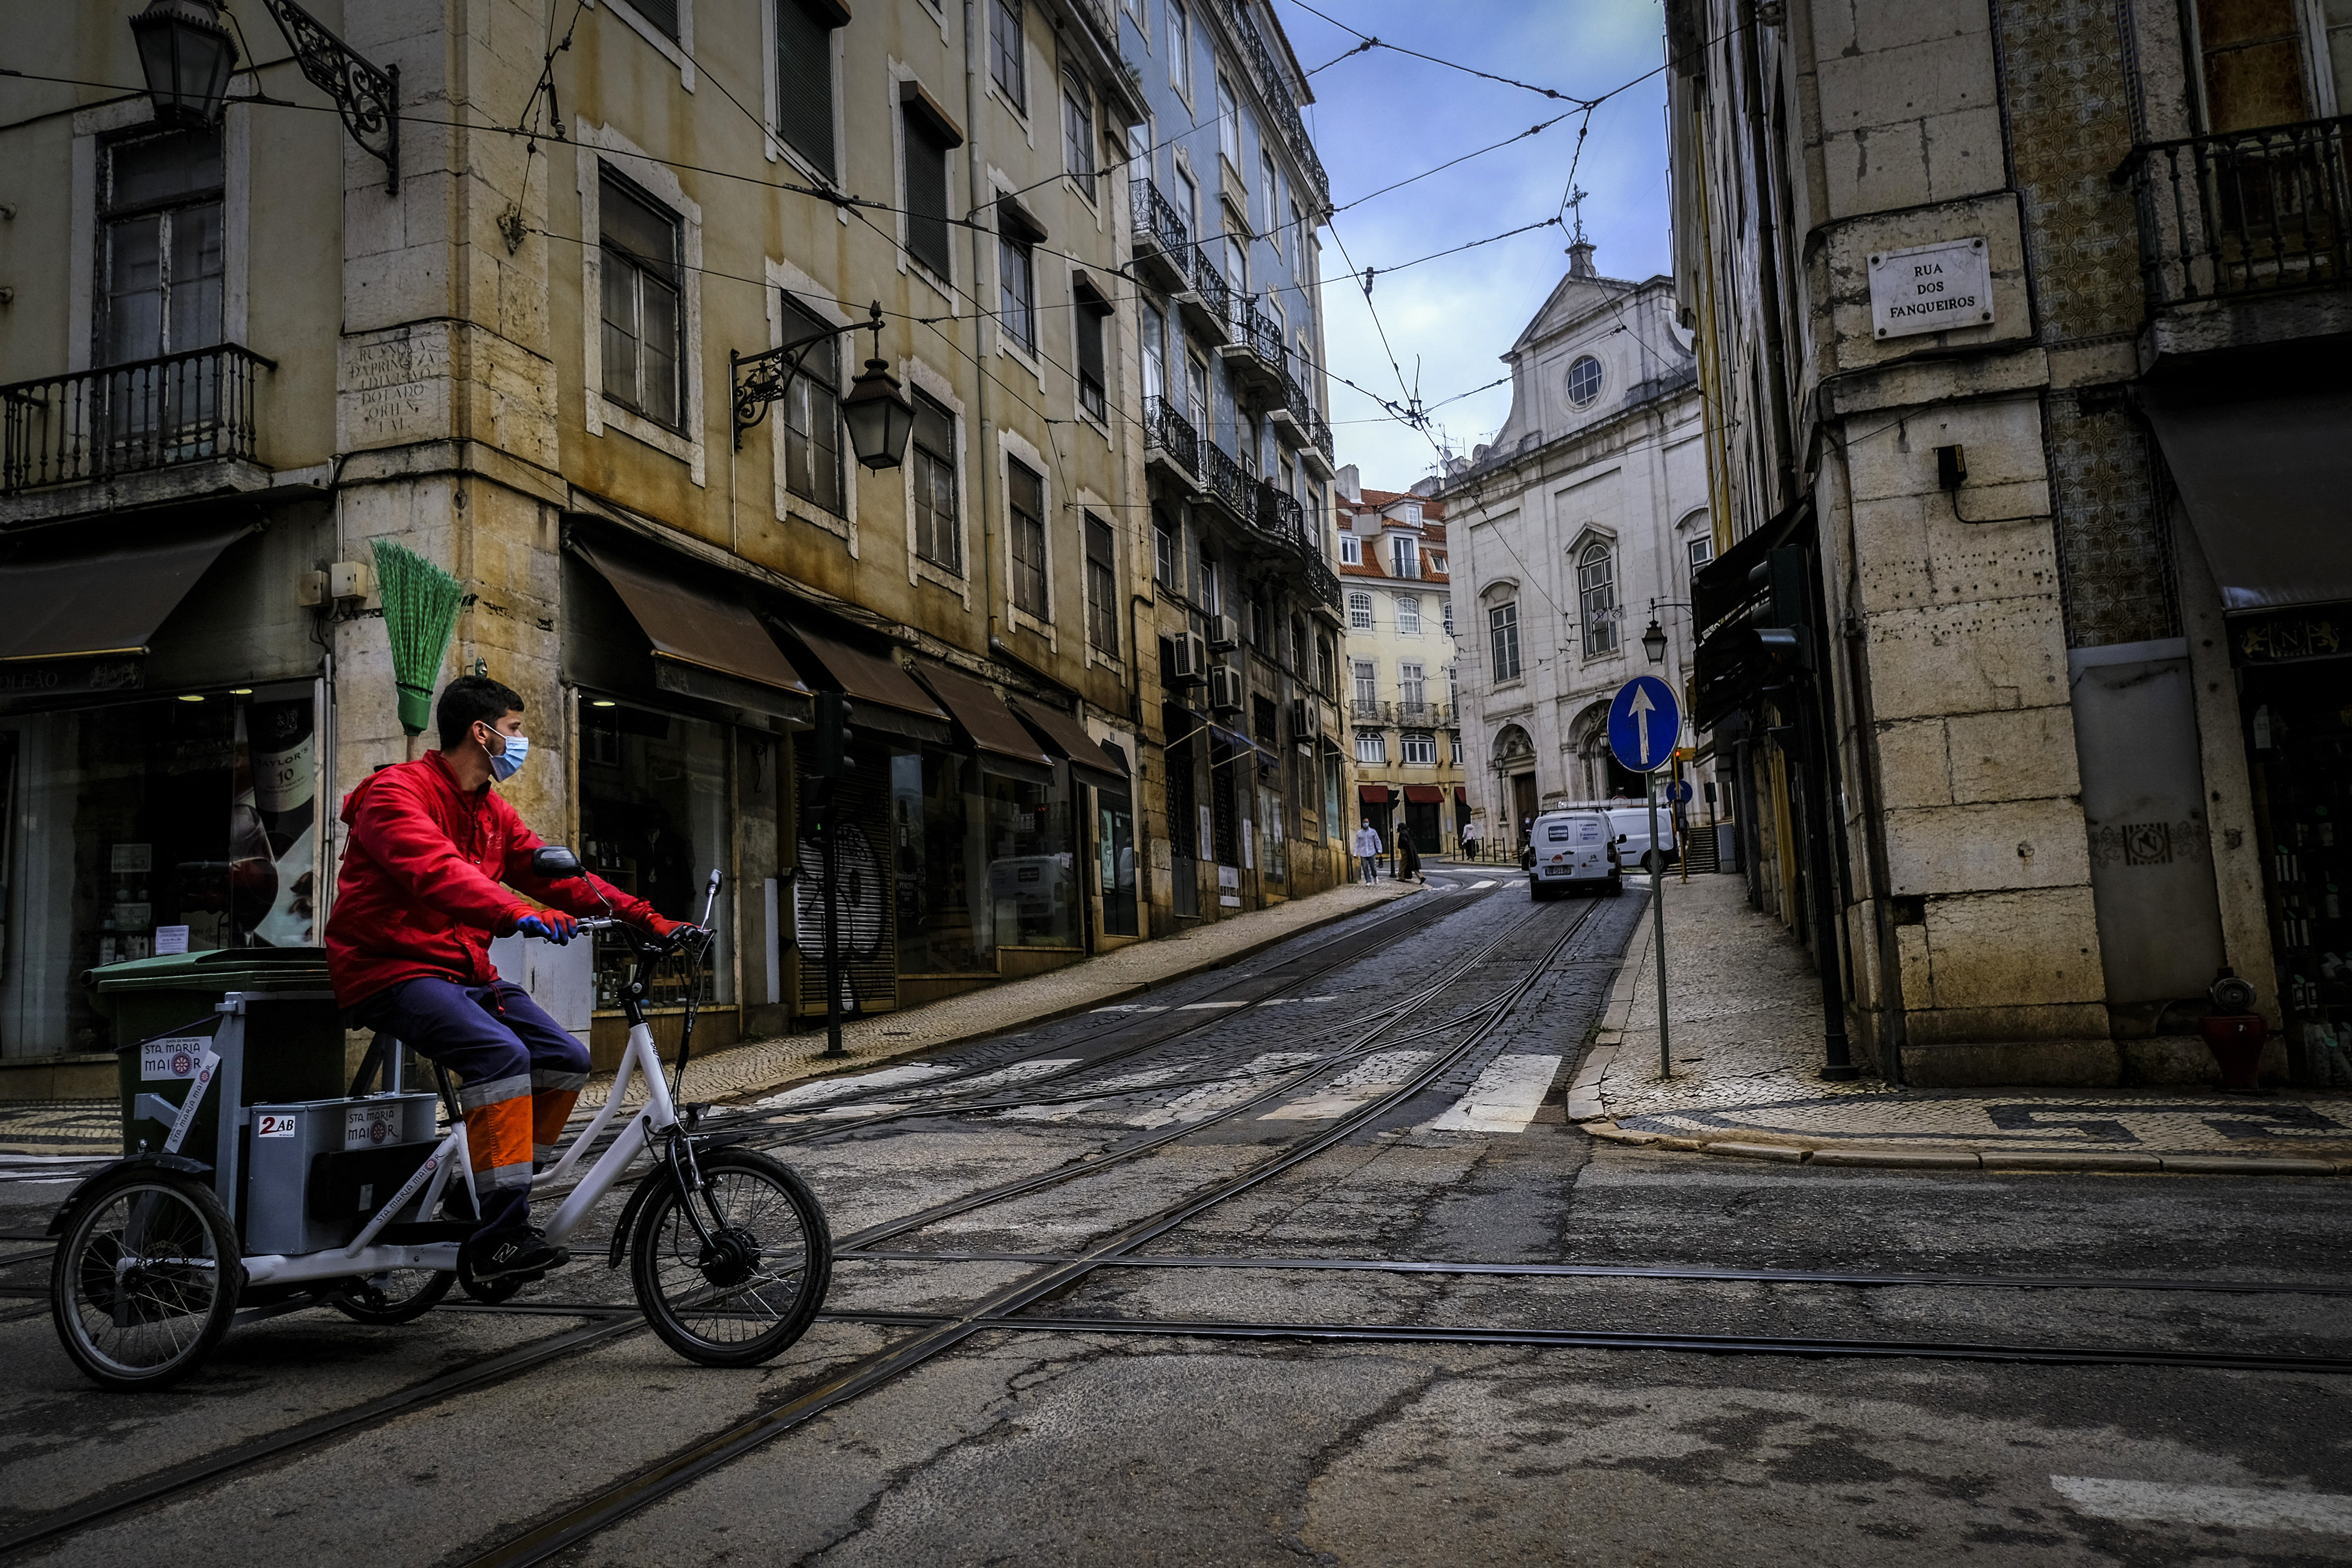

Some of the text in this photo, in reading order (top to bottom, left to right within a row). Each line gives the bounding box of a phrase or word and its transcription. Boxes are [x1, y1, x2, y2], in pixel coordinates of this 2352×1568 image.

[1915, 263, 1943, 277] RUA
[1917, 282, 1944, 295] DOS
[1890, 296, 1975, 318] FANQUEIROS
[2281, 630, 2298, 647] N
[278, 768, 293, 784] 10
[145, 1043, 201, 1054] STA. MARIA
[180, 1101, 195, 1128] MARIA
[349, 1110, 394, 1124] STA. MARIA
[390, 1185, 413, 1209] MARIA
[492, 1242, 518, 1263] N
